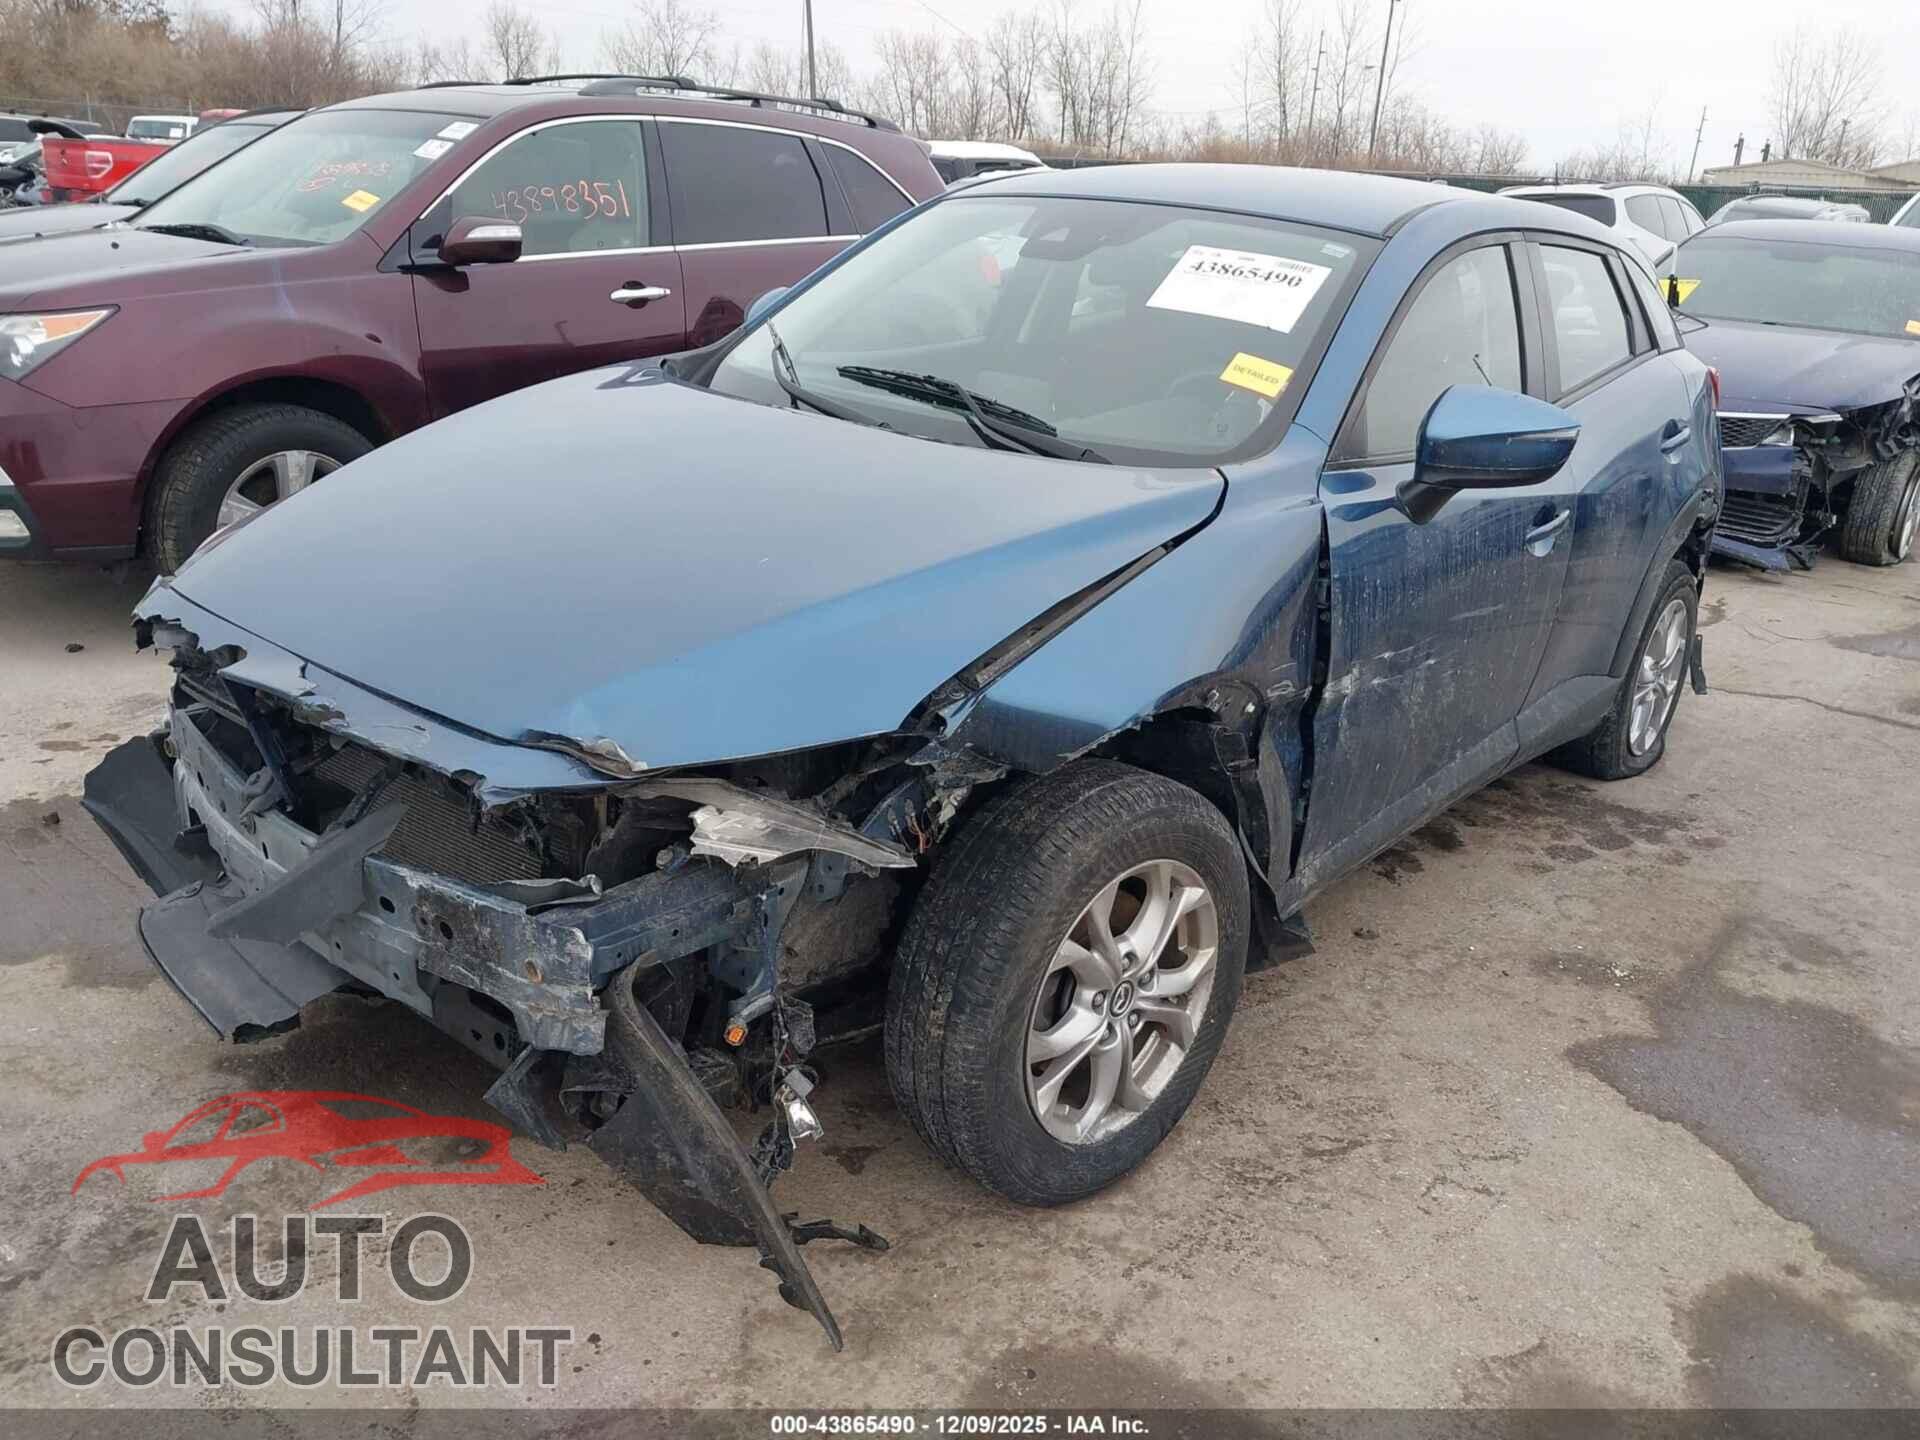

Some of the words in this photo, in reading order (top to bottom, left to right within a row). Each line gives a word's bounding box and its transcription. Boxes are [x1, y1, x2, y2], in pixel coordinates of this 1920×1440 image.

[492, 179, 630, 225] 43898351
[1190, 260, 1303, 288] 43865490
[1233, 364, 1280, 384] DETAILED
